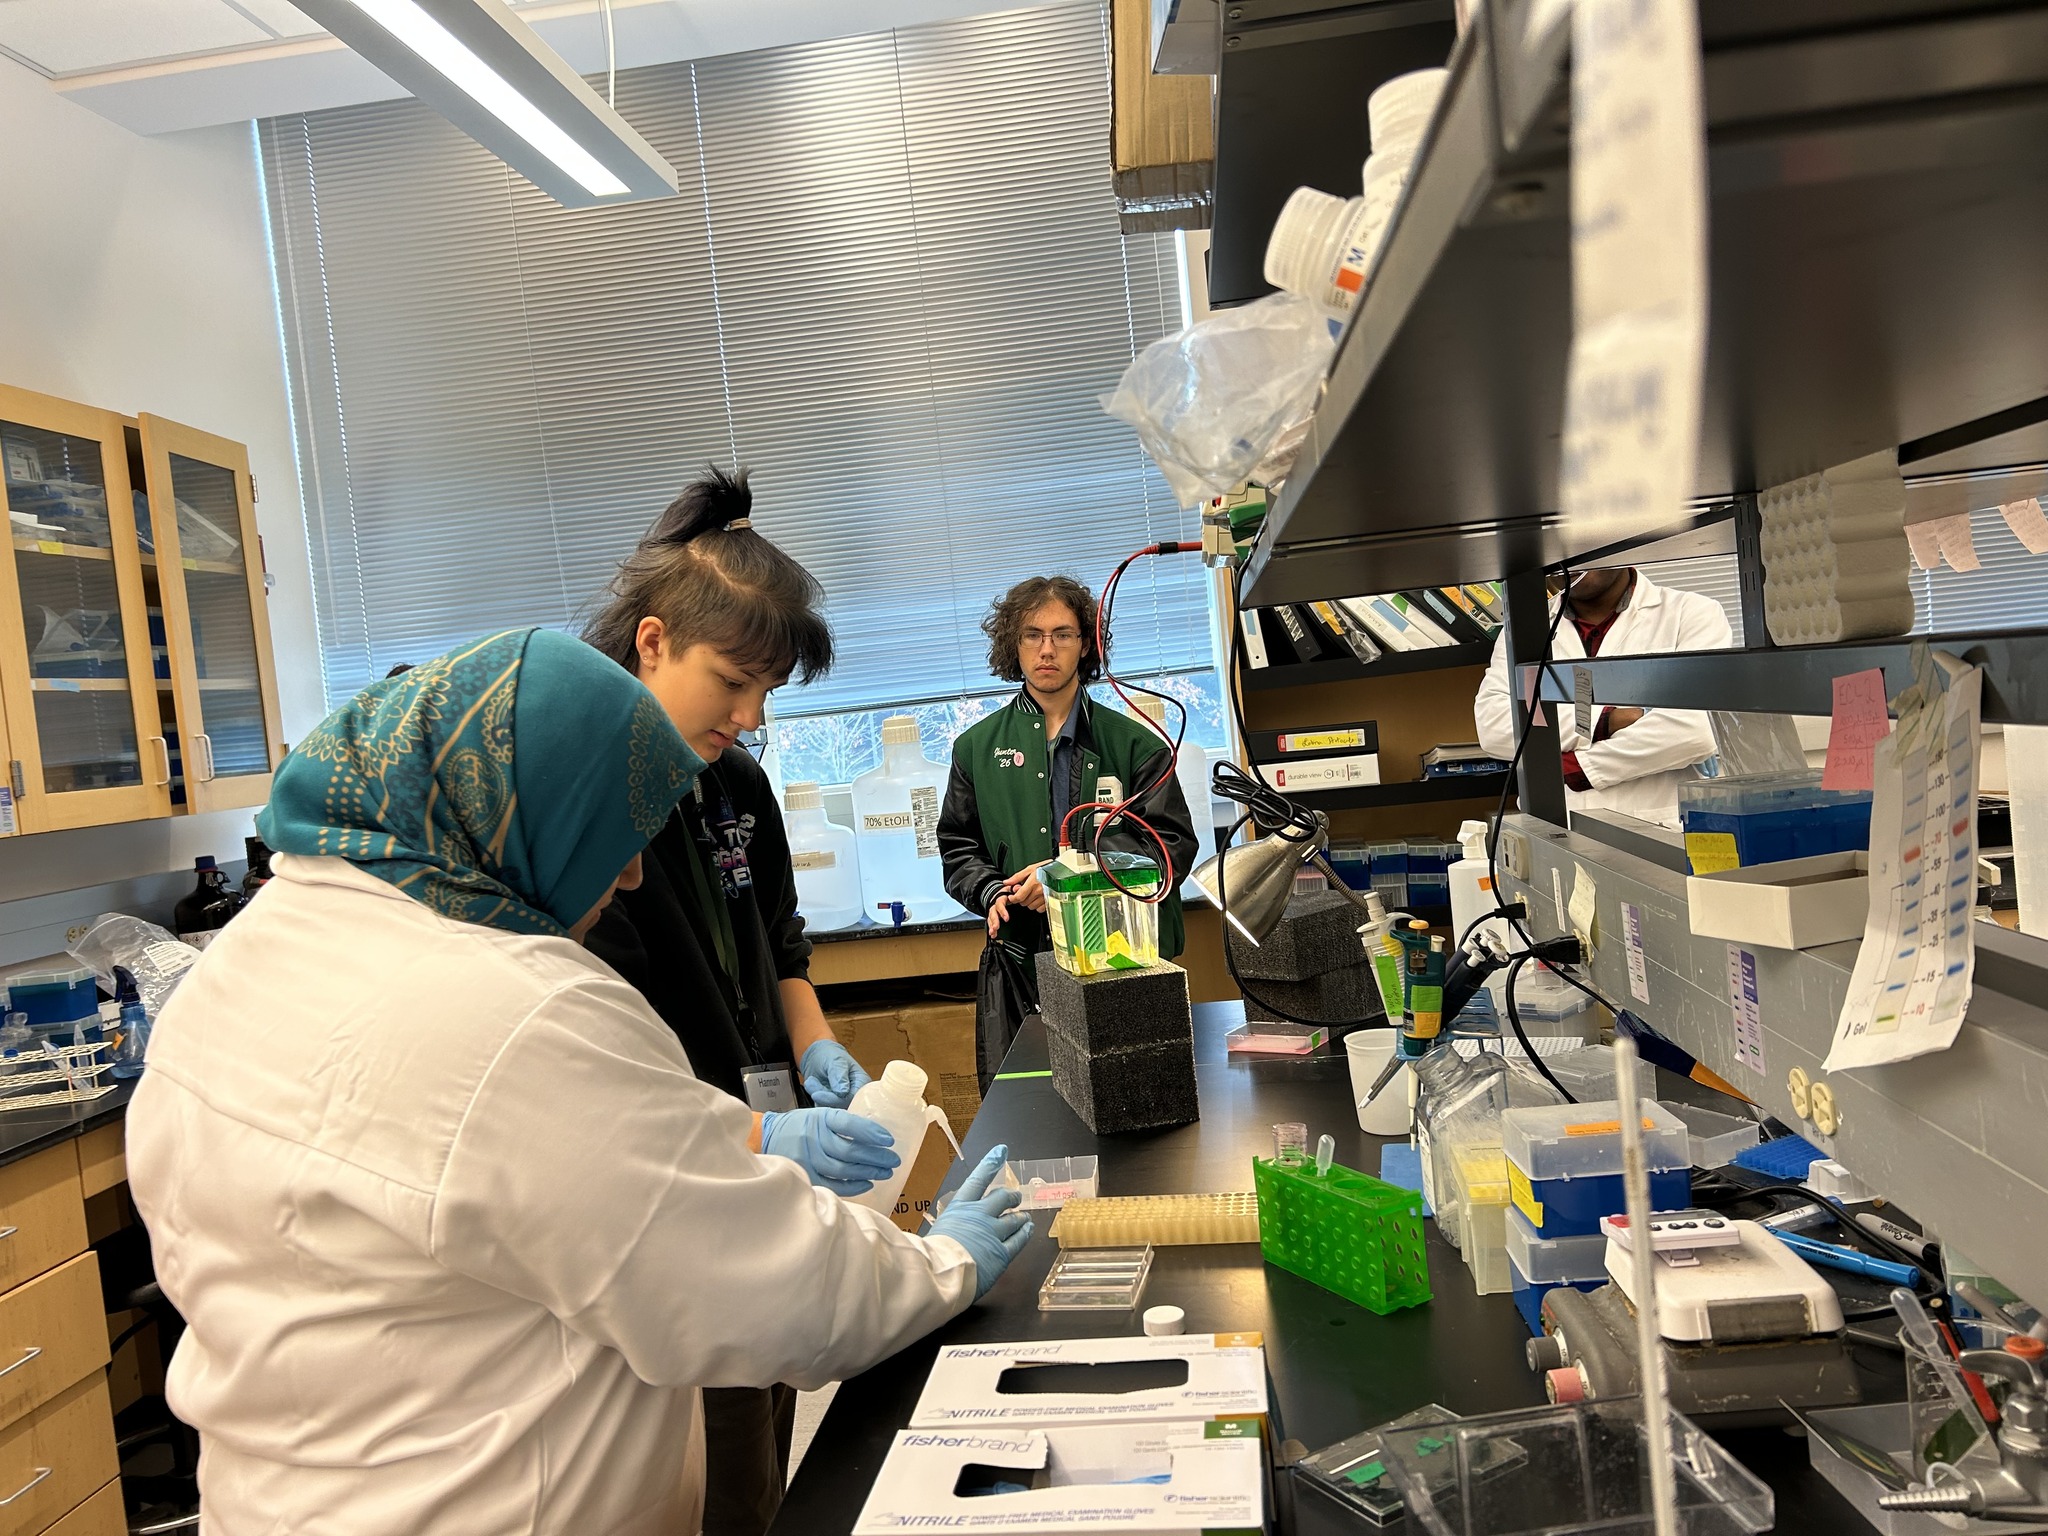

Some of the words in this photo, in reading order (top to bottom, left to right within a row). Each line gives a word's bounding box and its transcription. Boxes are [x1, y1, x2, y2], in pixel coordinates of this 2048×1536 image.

[1098, 796, 1114, 804] BAND
[865, 817, 882, 827] 70%
[884, 815, 910, 826] EtOH
[1916, 1003, 1925, 1015] 10
[1853, 1022, 1867, 1035] Gel
[757, 1077, 780, 1088] Hannah
[892, 1203, 909, 1215] ND
[915, 1200, 931, 1212] UP
[1820, 1250, 1840, 1261] Office
[946, 1344, 1063, 1359] fisherbrand
[948, 1407, 1010, 1419] NITRILE
[902, 1435, 1034, 1453] fisherbrand
[898, 1515, 969, 1526] NITRILE
